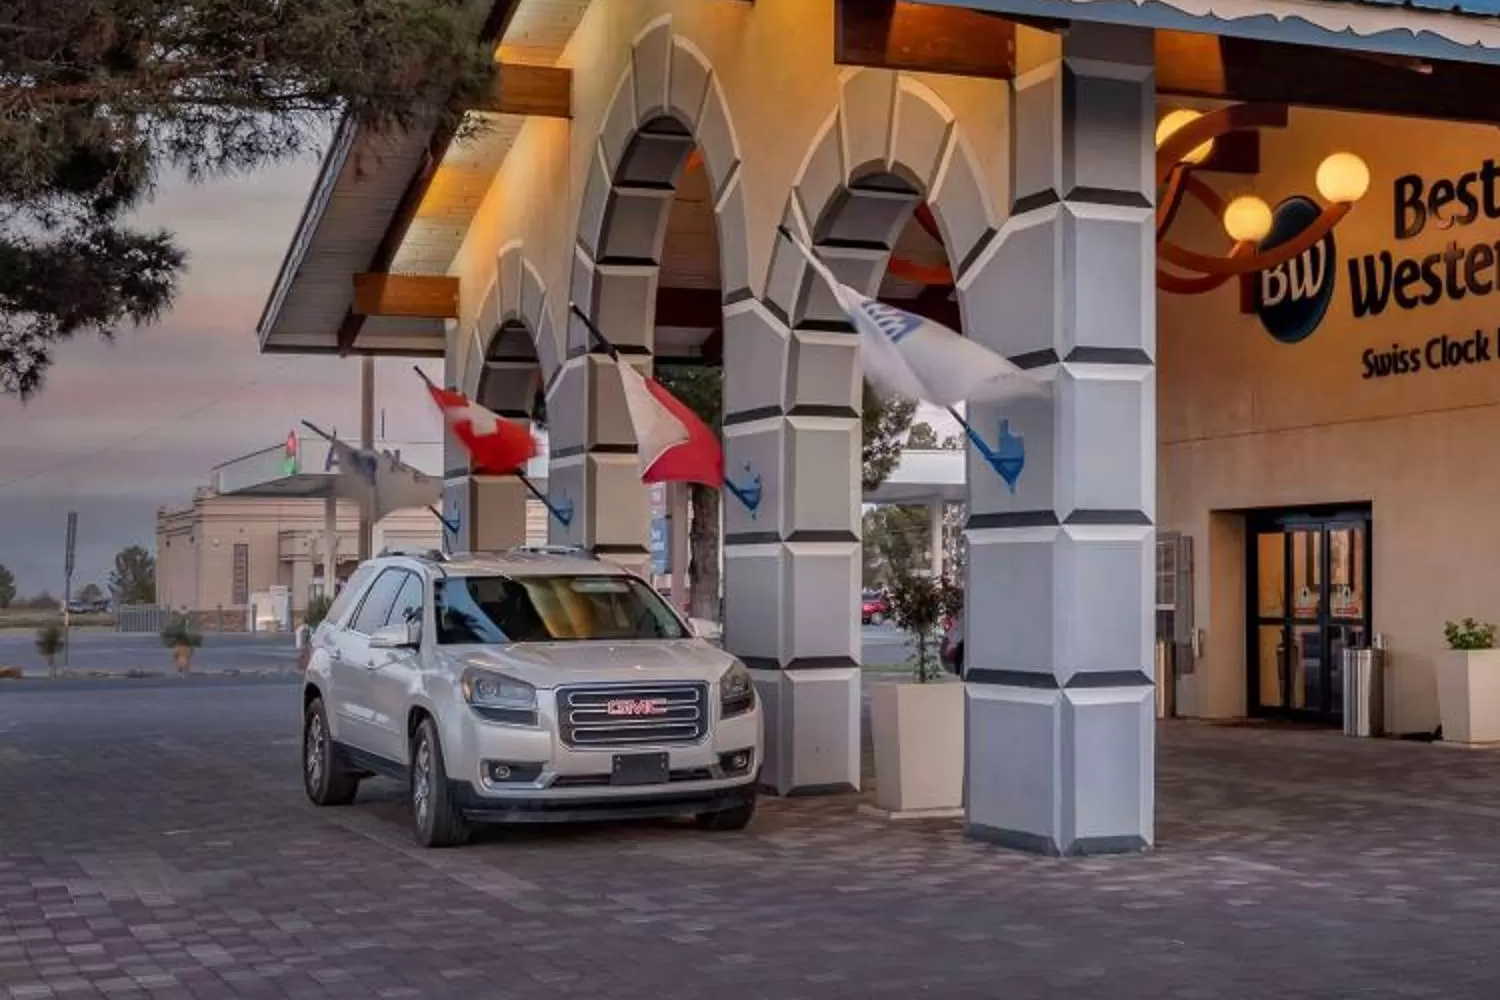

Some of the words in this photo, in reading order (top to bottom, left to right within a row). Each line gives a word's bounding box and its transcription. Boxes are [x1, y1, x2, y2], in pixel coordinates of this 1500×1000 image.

[1262, 238, 1326, 307] BW
[1361, 343, 1421, 380] Swiss
[1424, 329, 1490, 370] Clock
